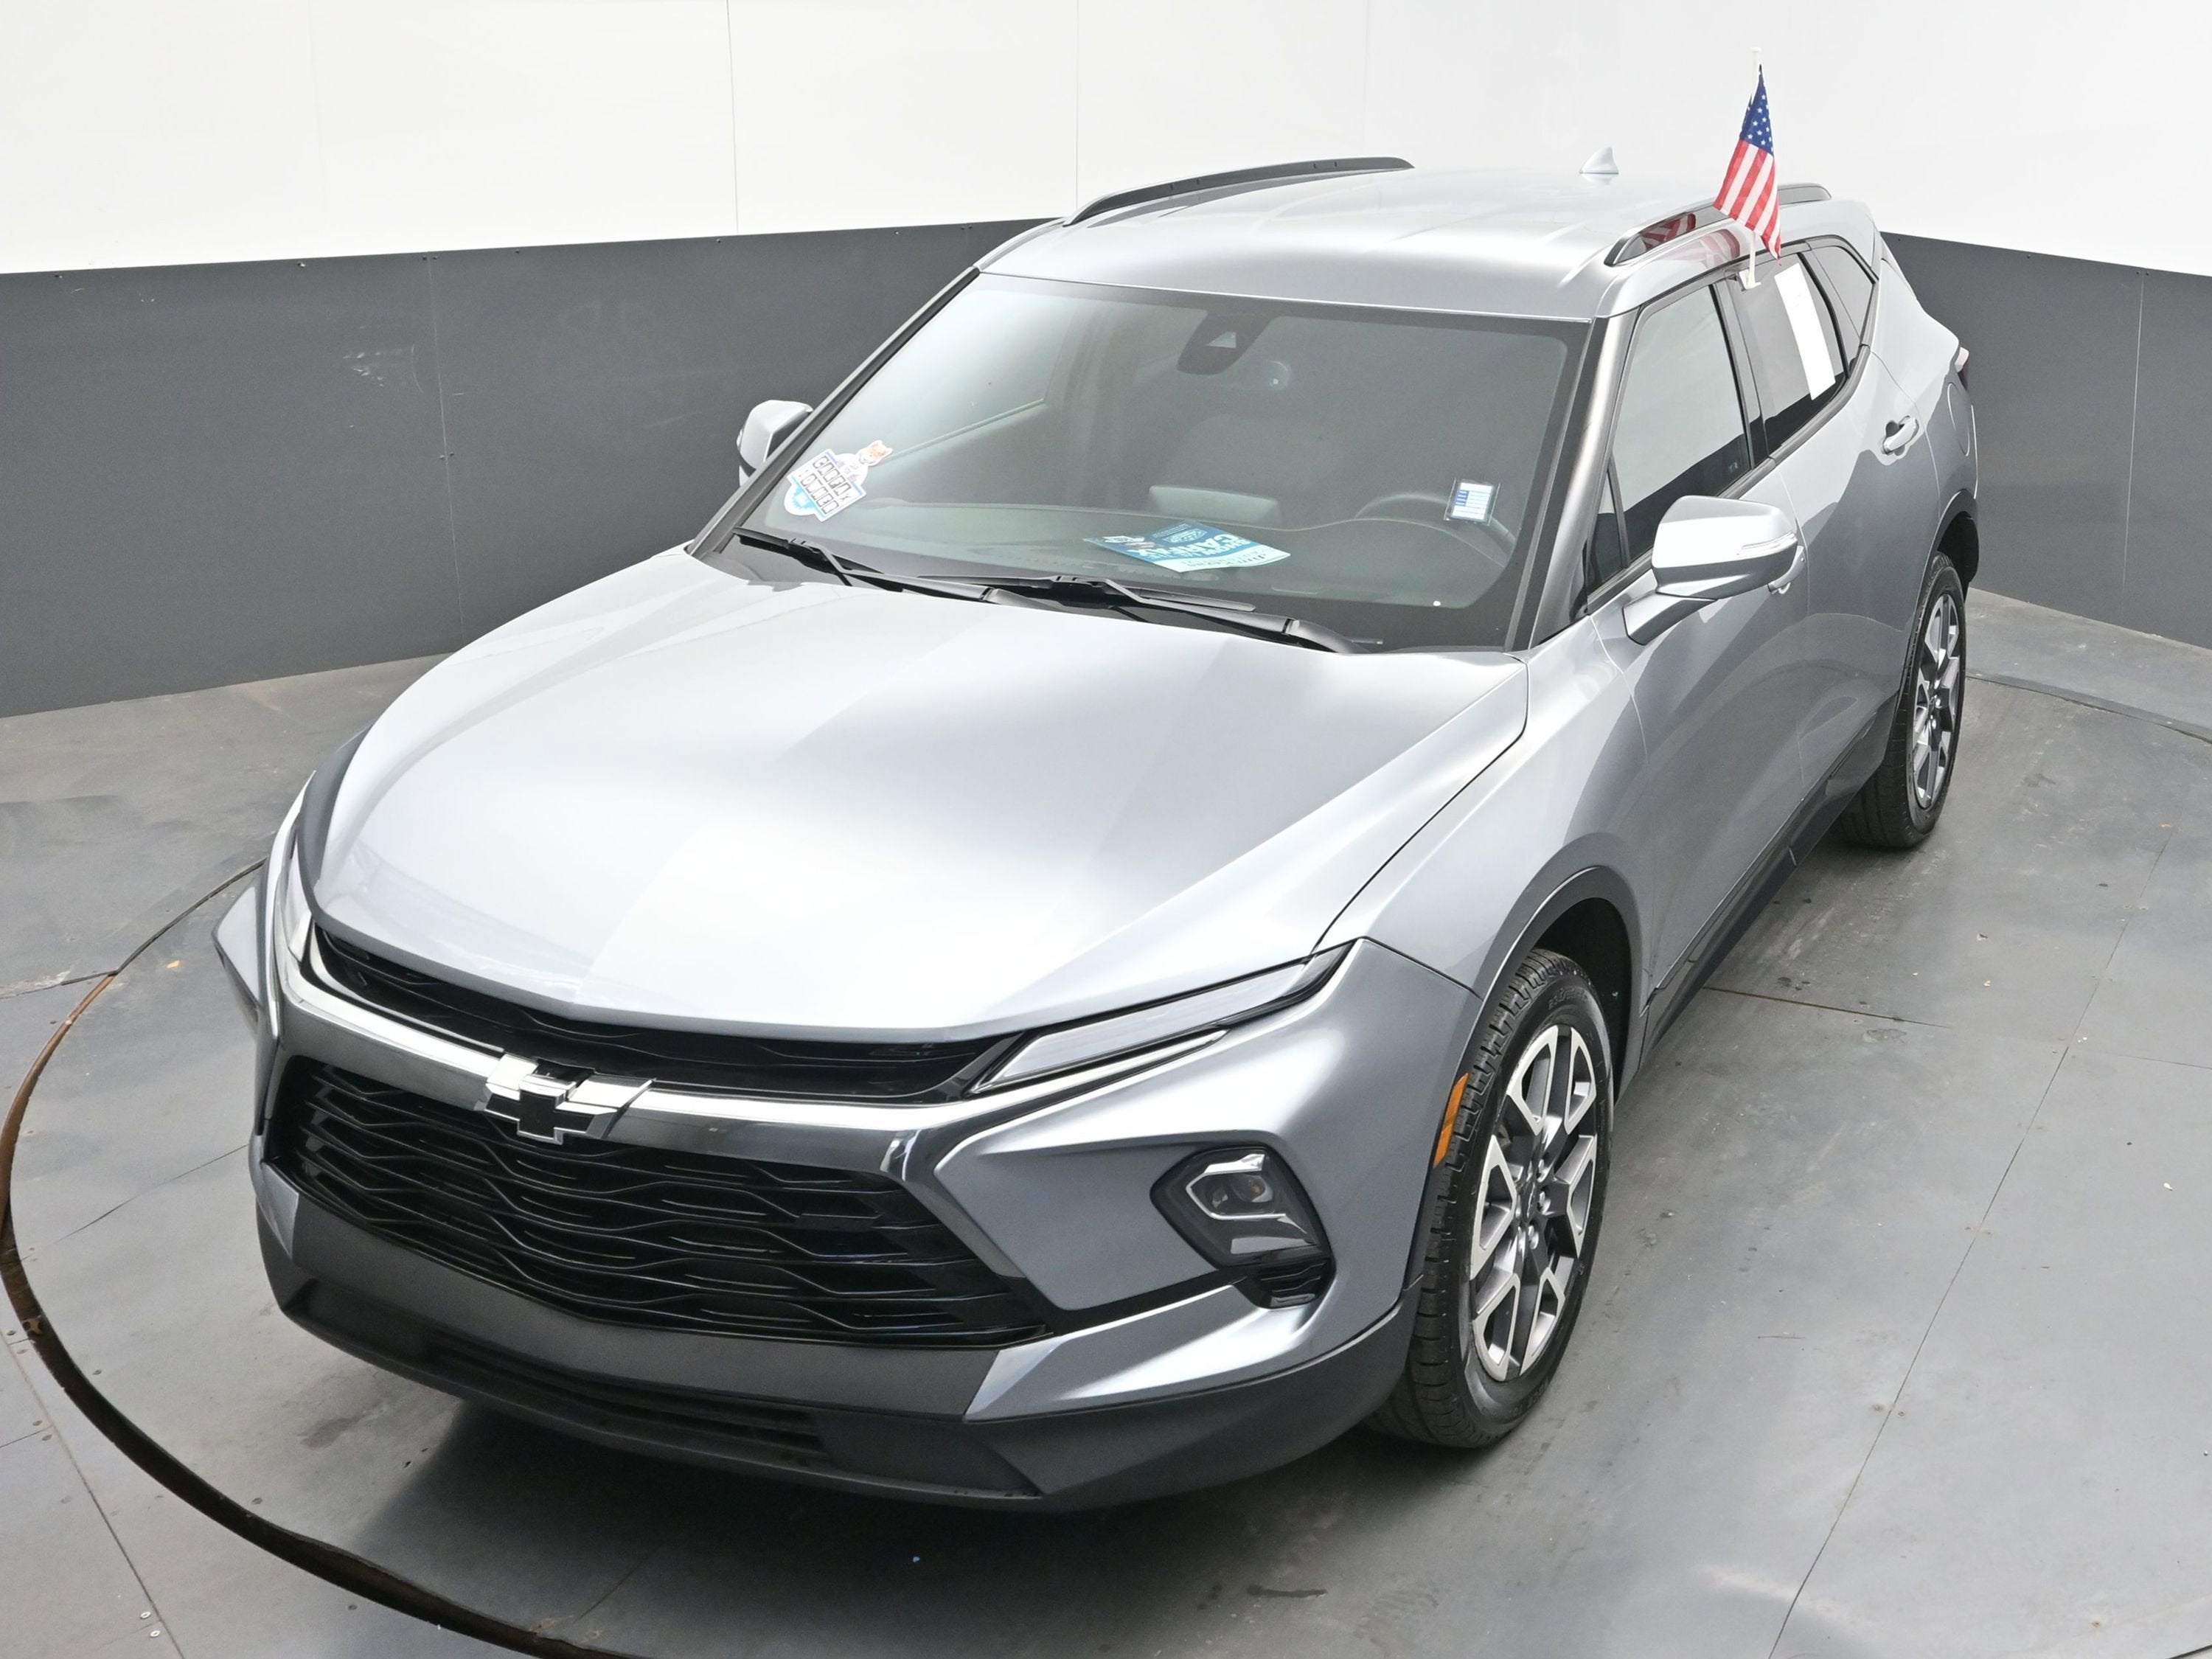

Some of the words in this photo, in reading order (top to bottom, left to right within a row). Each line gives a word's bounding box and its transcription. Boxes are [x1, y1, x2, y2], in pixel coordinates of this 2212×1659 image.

[800, 473, 839, 515] OWNER
[813, 456, 852, 502] CARFAX
[1127, 533, 1239, 557] CARFAX
[1199, 538, 1251, 555] SHOW
